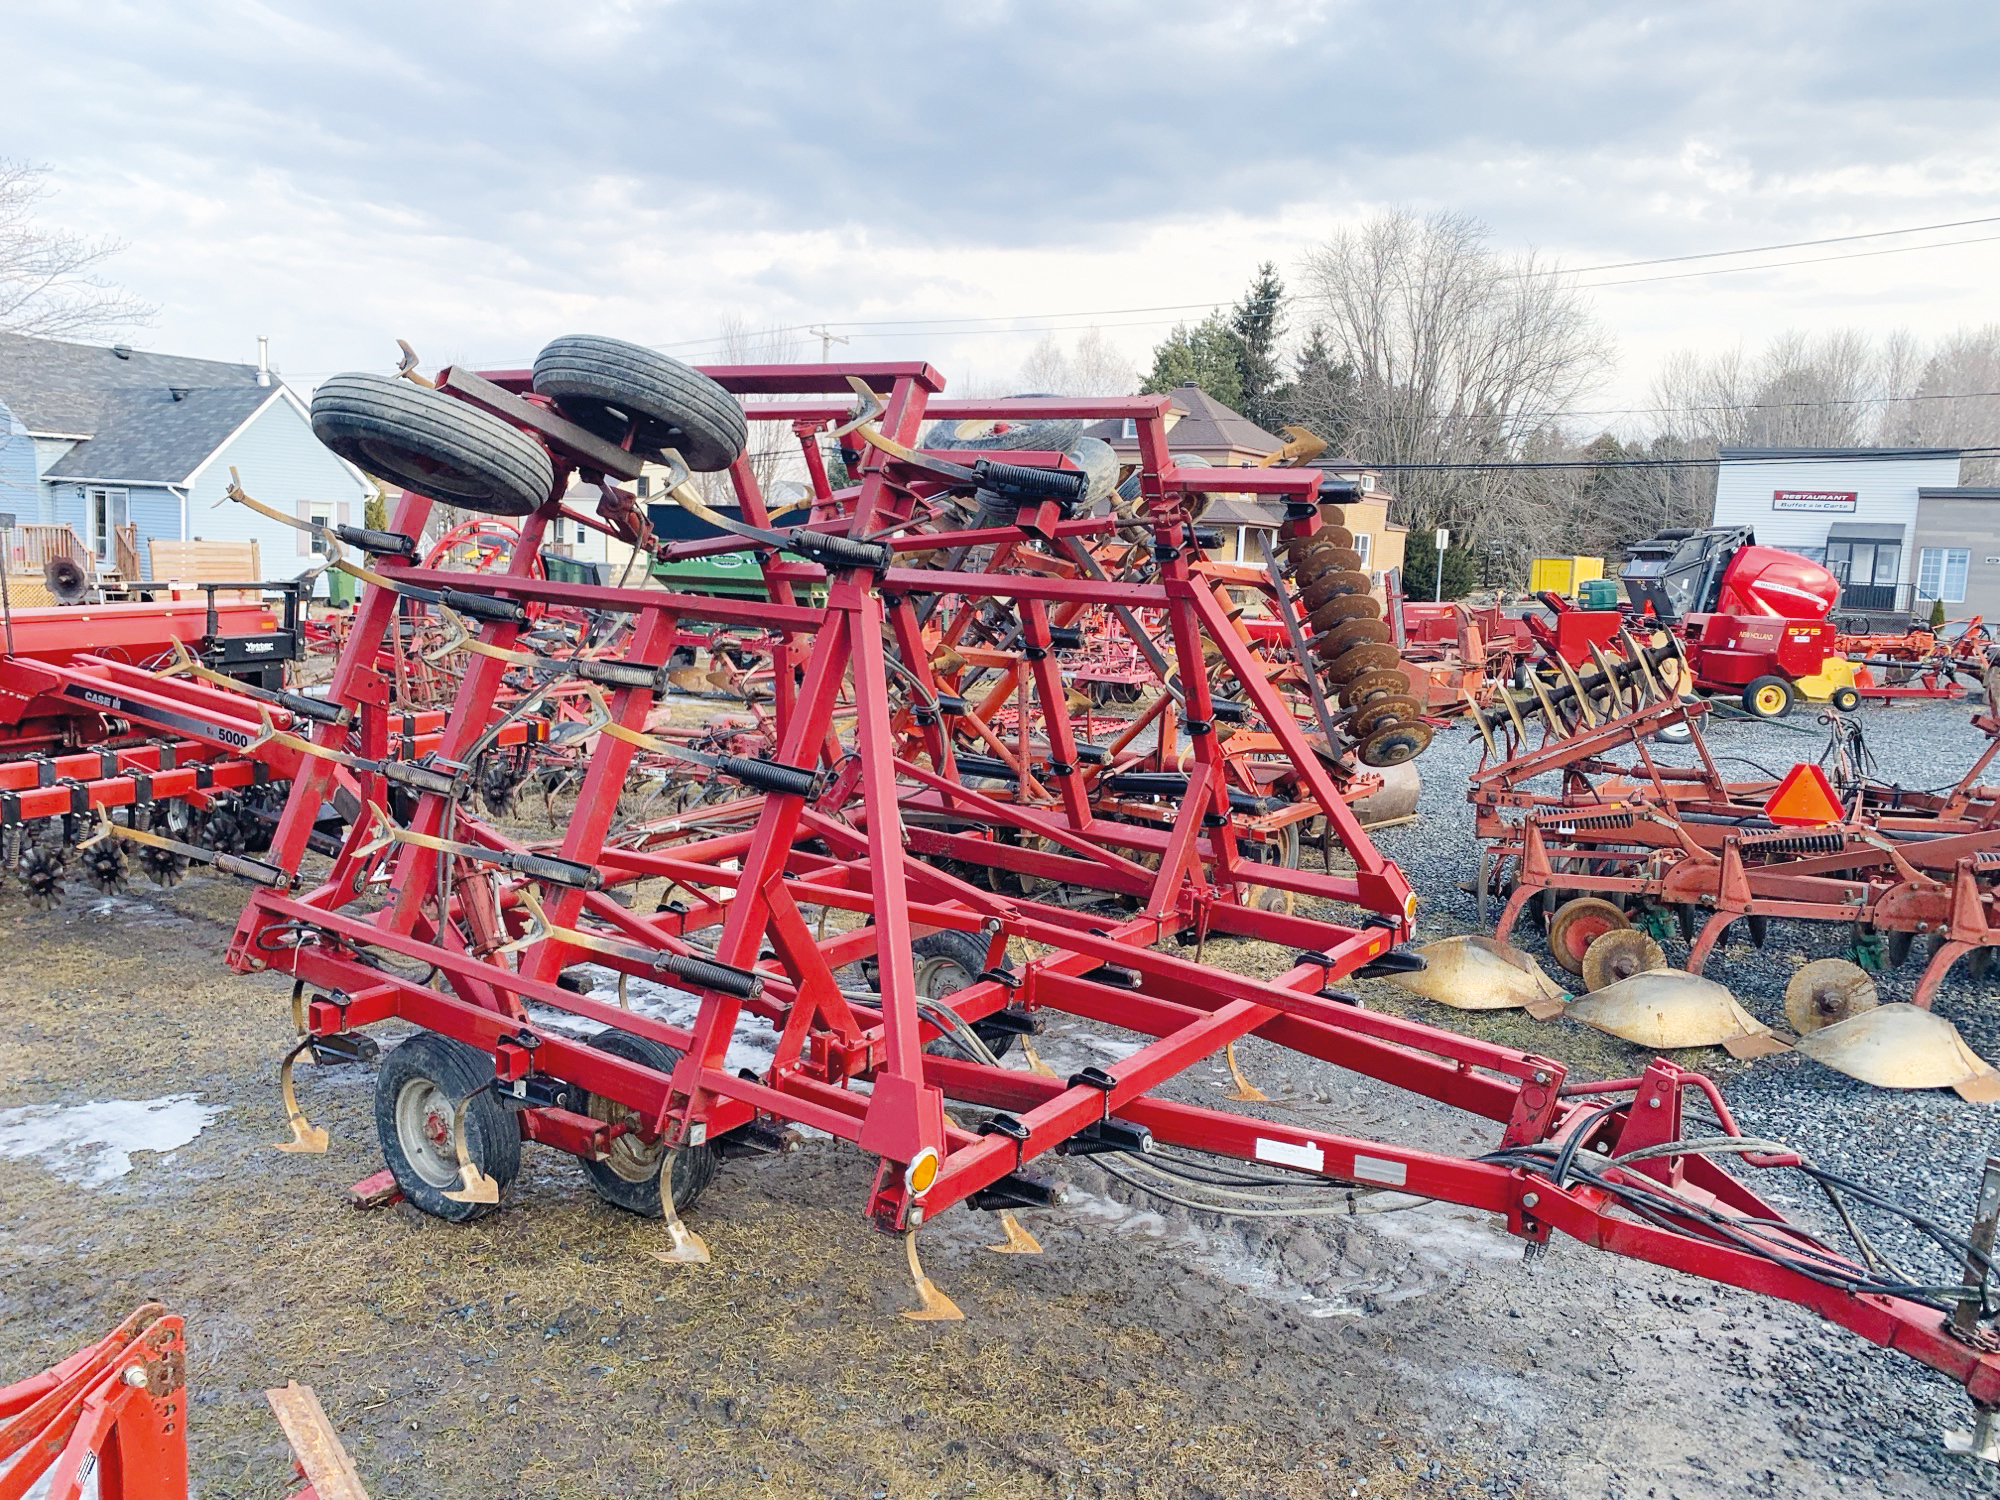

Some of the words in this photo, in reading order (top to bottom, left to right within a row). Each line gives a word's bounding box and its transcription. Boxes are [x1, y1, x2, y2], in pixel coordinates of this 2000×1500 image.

[1750, 632, 1773, 640] HOLLAND
[1788, 628, 1822, 636] 575
[84, 691, 111, 707] CASE
[218, 728, 248, 748] 5000
